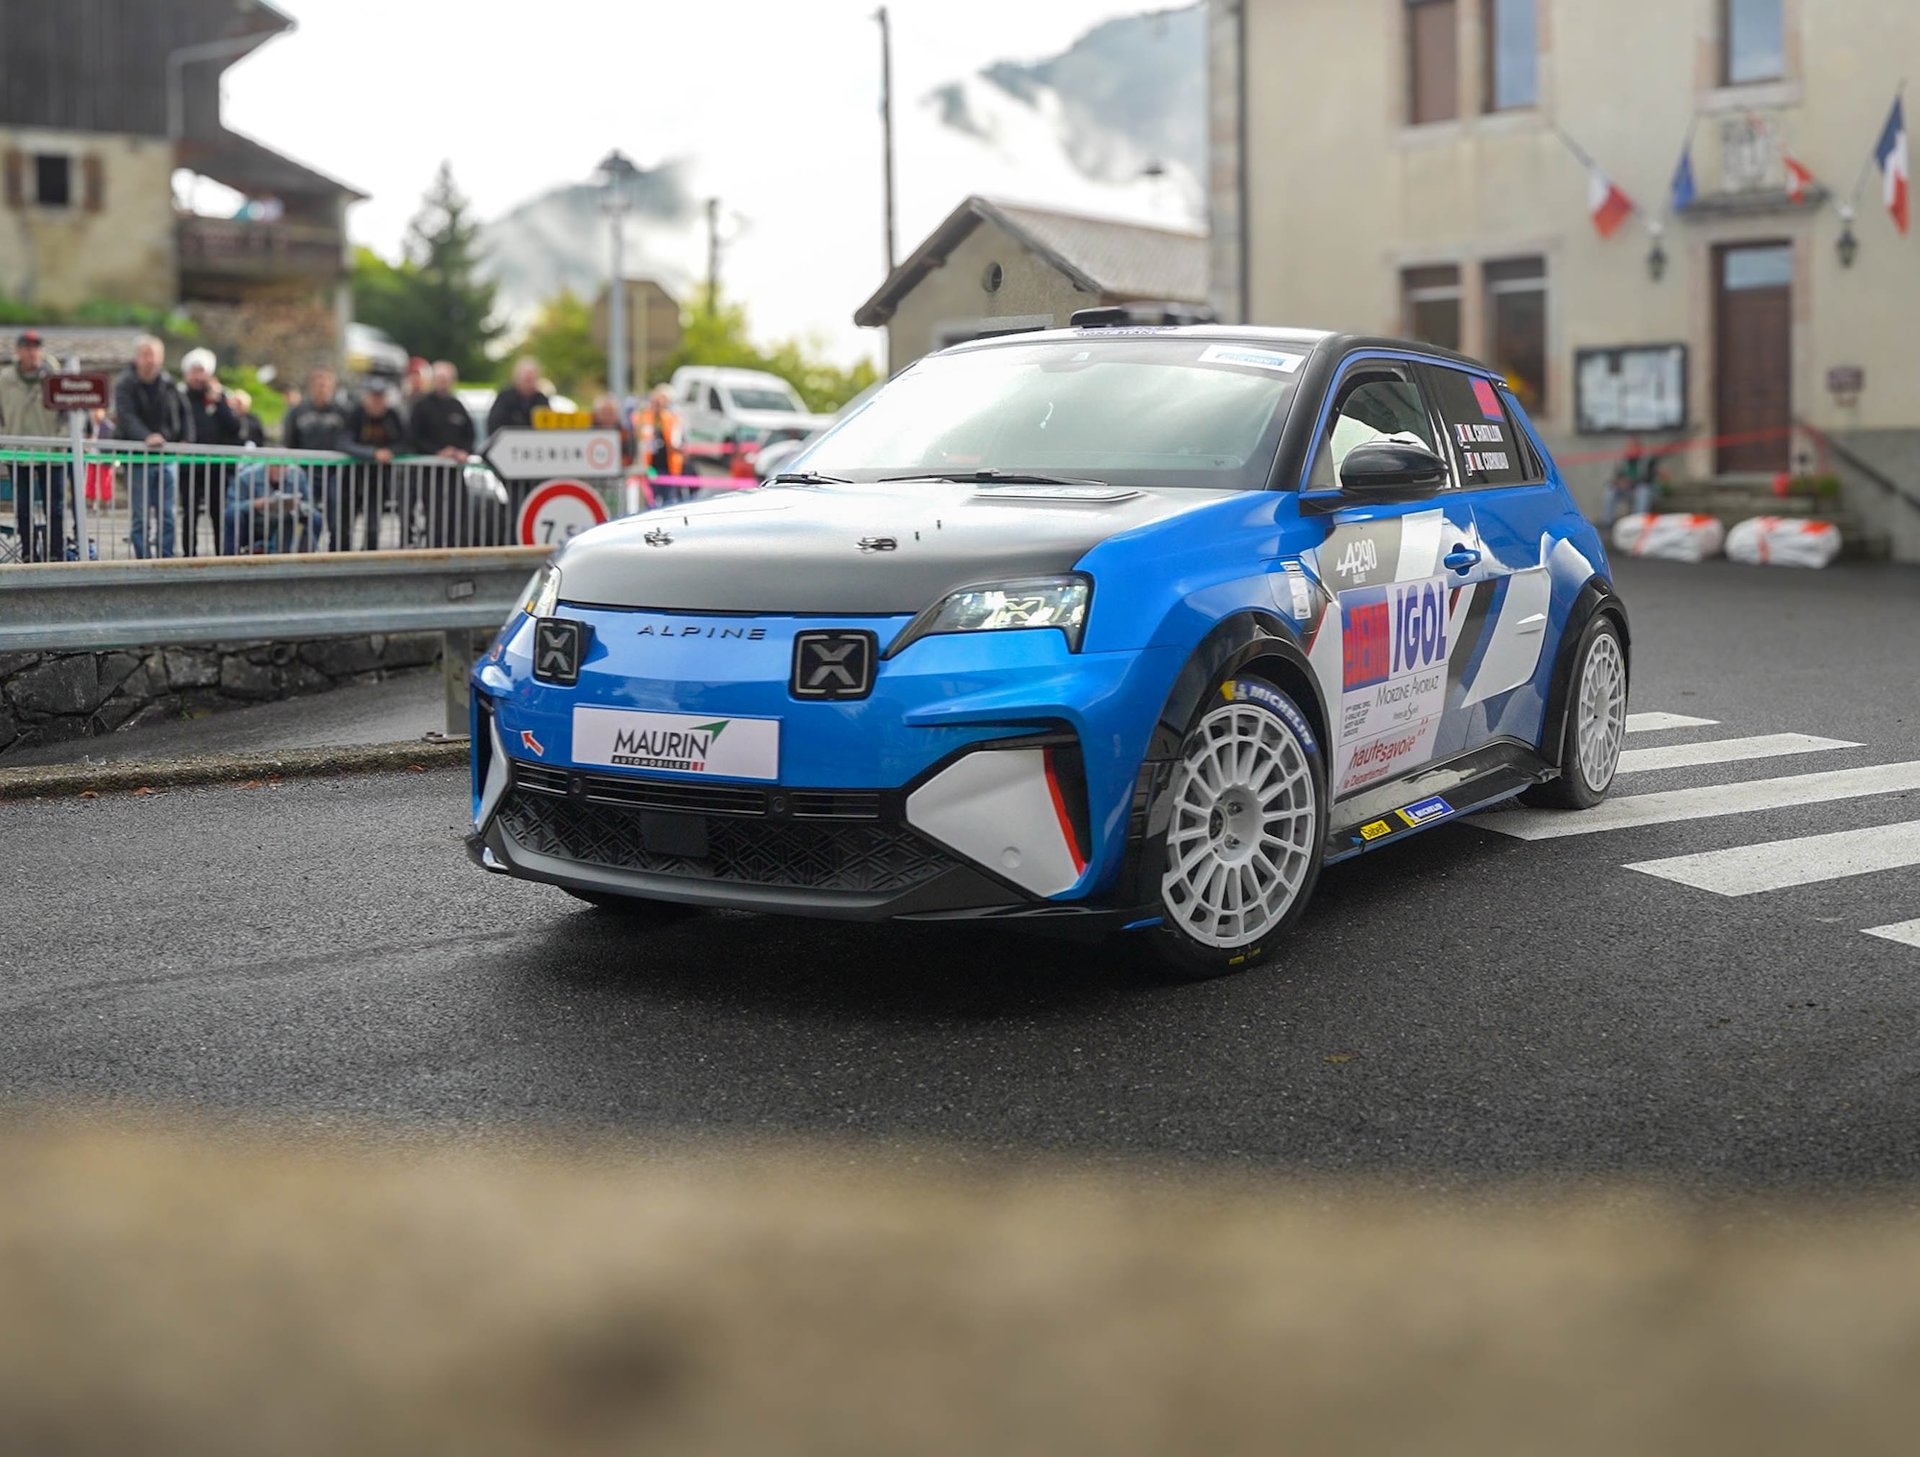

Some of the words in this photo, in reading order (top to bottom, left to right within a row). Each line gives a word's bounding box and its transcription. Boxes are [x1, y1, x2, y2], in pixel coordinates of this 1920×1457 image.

[1336, 538, 1378, 577] A290
[637, 625, 767, 641] ALPINE
[1393, 581, 1447, 673] IGOL
[1249, 685, 1313, 745] MICHELIN
[612, 727, 710, 761] MAURIN
[612, 756, 690, 771] AUTOMOBILES
